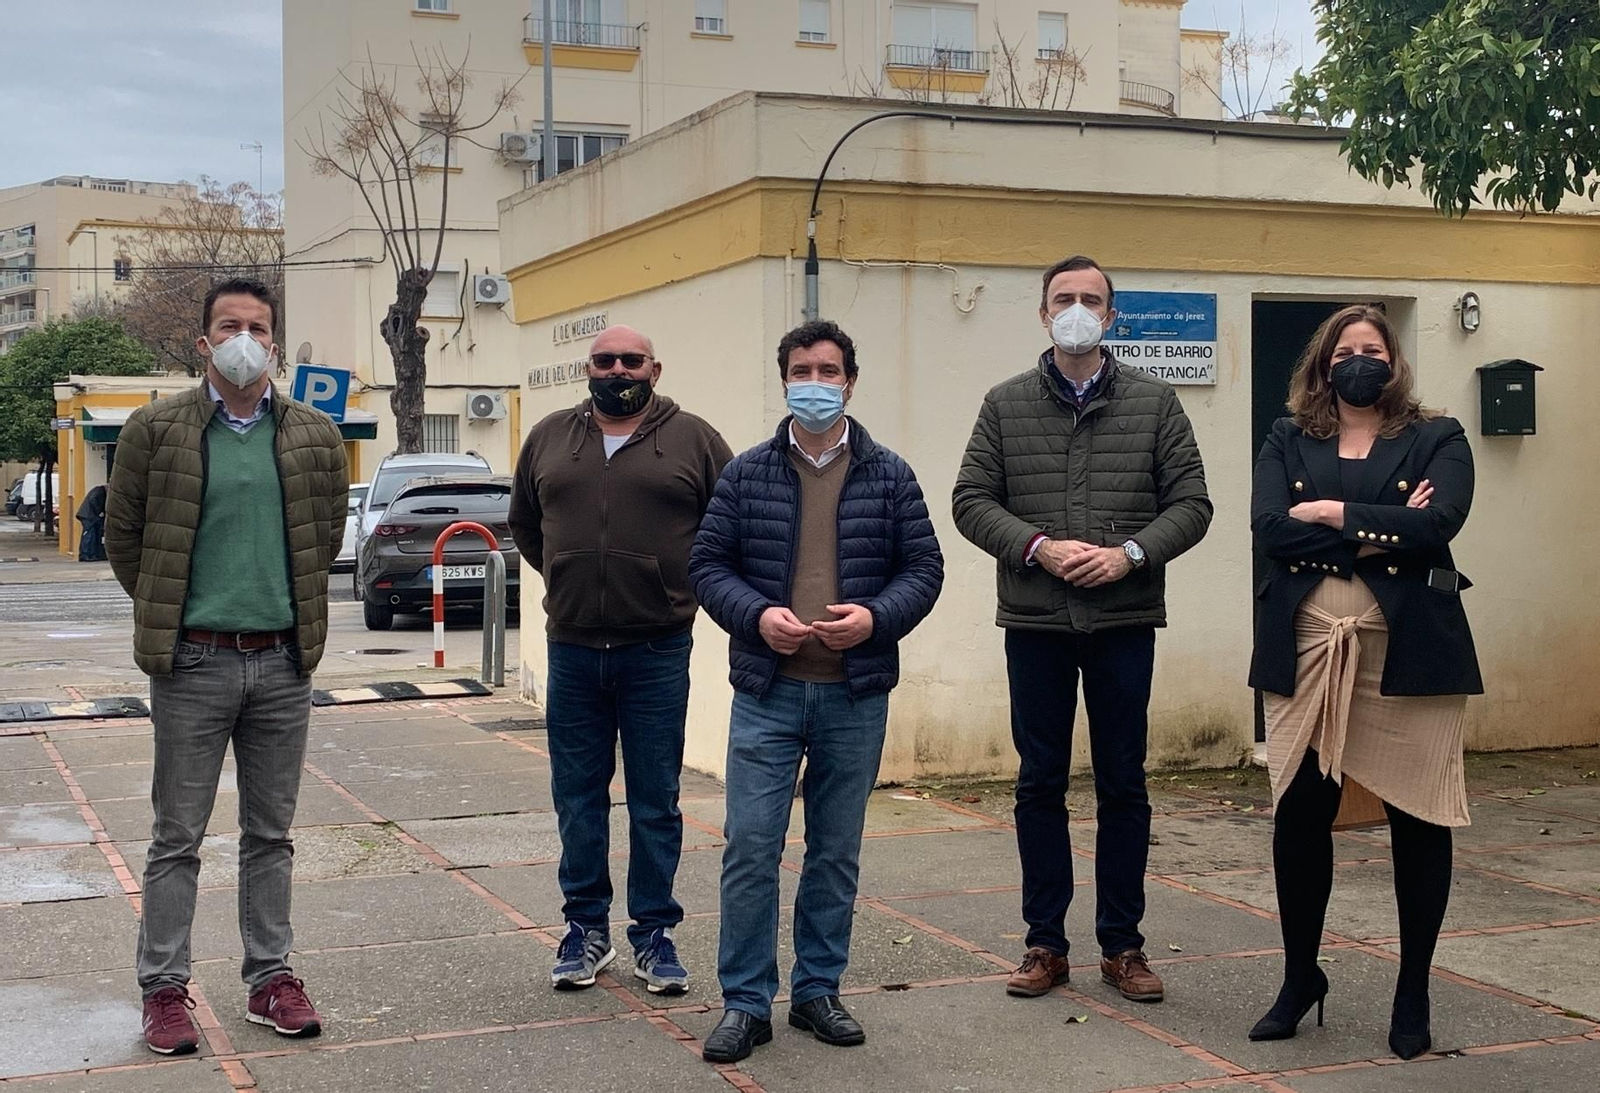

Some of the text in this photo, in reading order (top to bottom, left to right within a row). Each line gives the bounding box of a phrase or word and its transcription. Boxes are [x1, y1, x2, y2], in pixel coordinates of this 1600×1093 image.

[1117, 311, 1205, 322] Ayuntamiento de Jerez
[1100, 345, 1212, 358] NTRO DE BARRIO
[569, 361, 590, 379] CARM
[303, 372, 338, 406] P
[442, 568, 460, 577] 625
